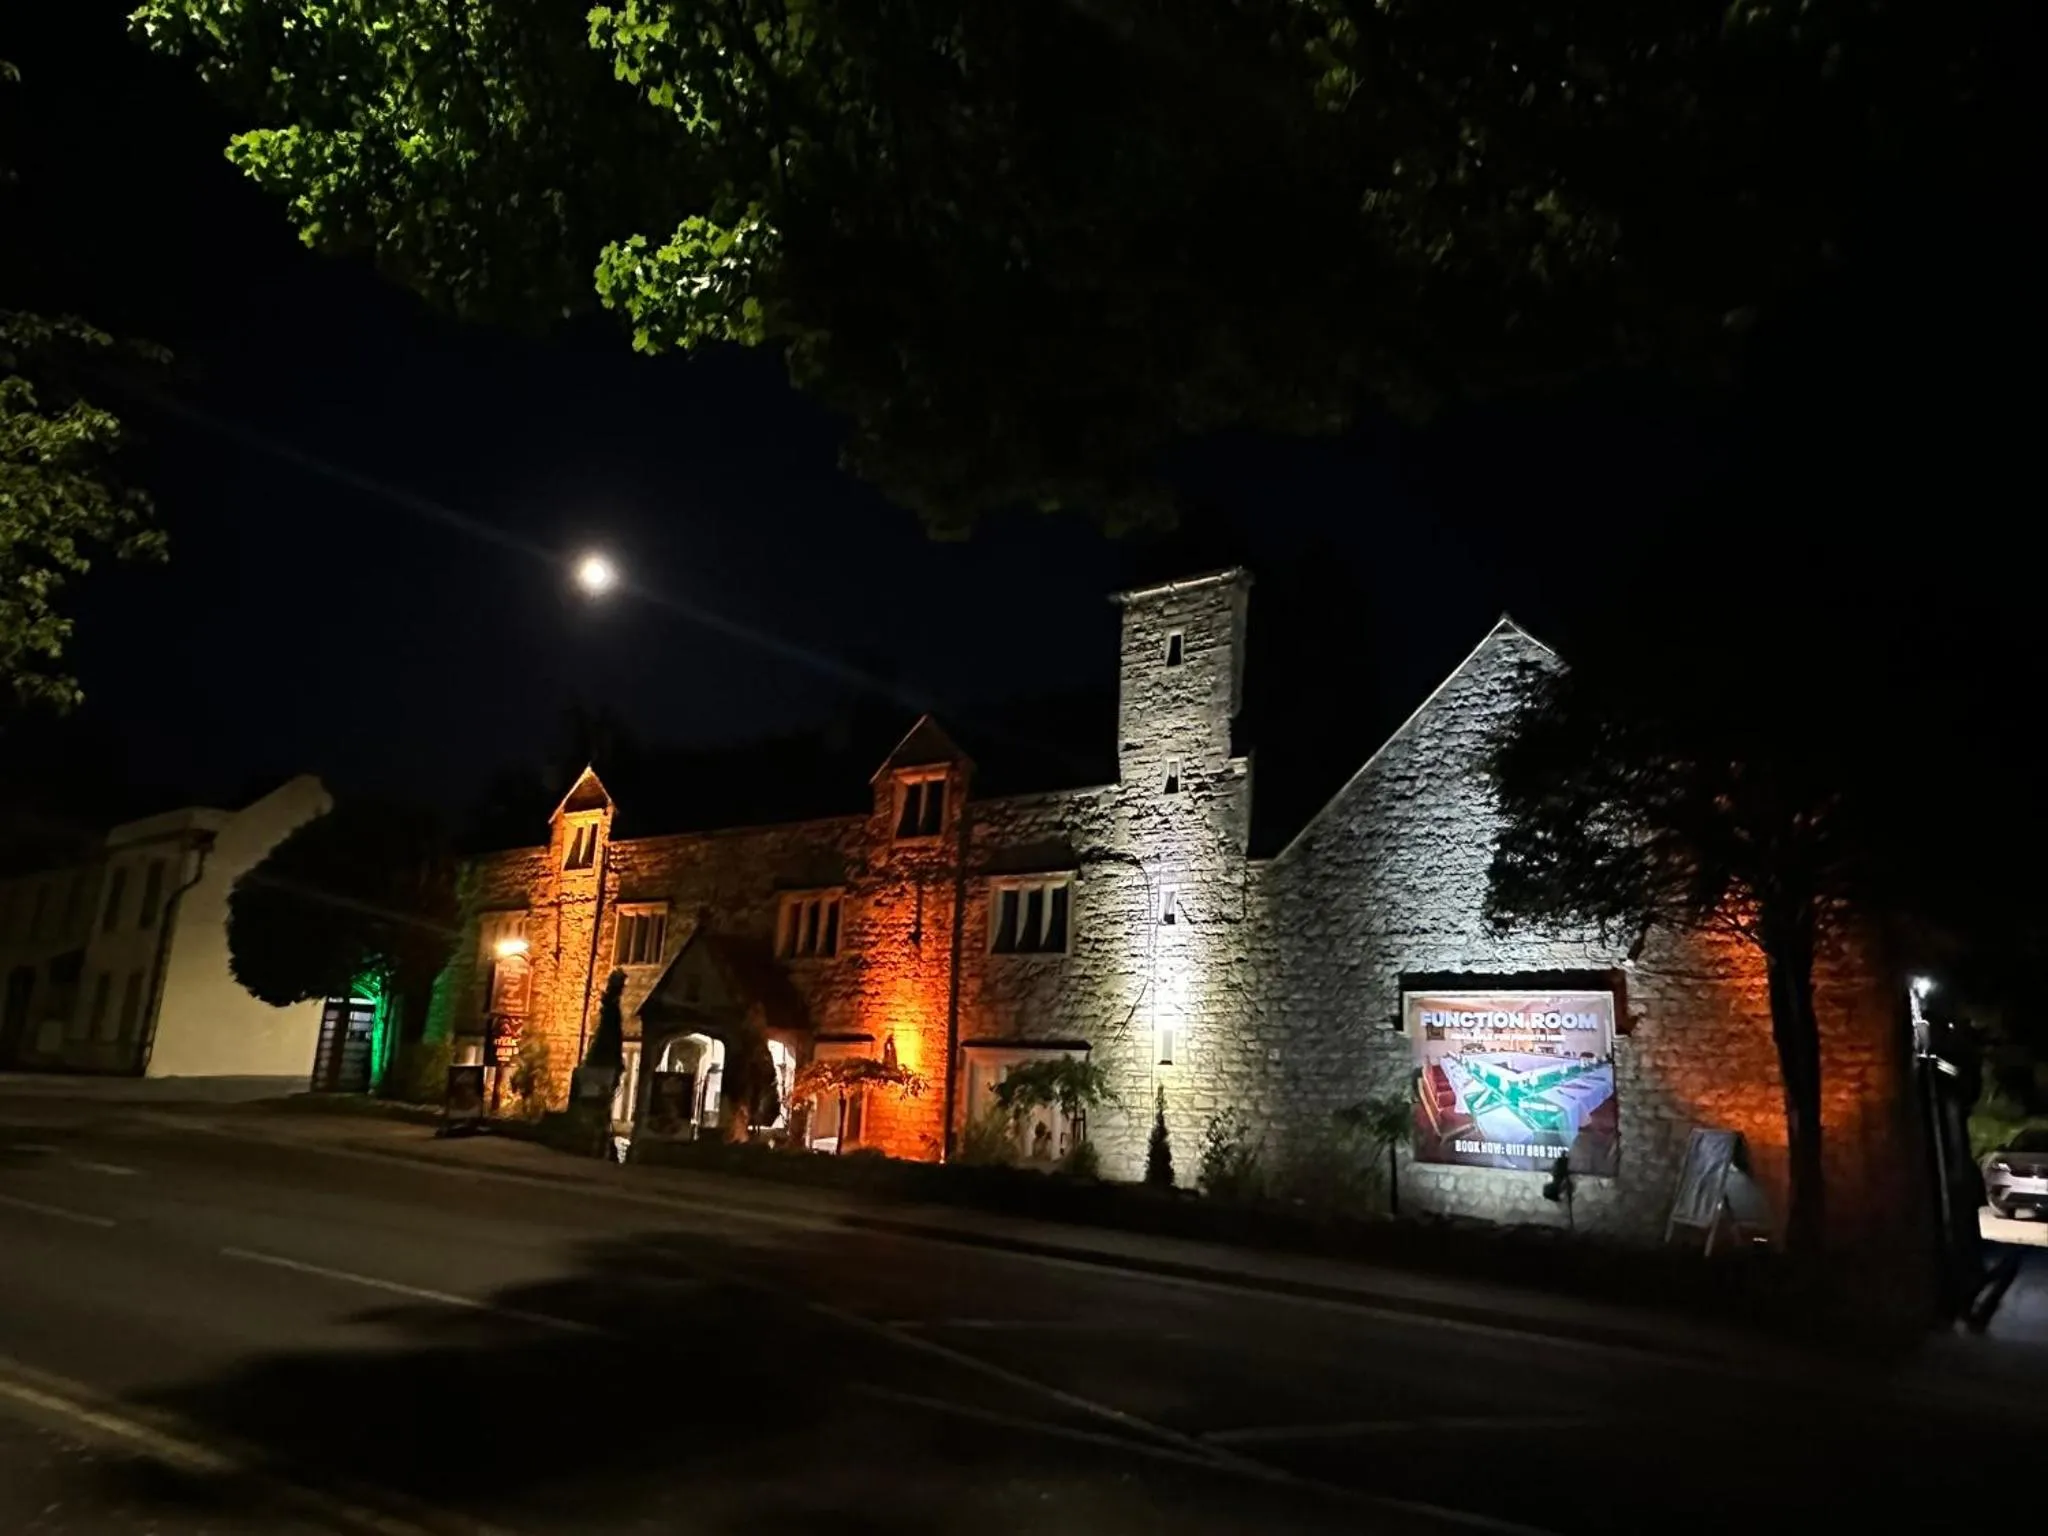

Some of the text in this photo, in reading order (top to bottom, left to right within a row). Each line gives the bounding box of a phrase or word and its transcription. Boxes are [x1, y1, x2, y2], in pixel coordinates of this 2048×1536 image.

[1420, 1011, 1598, 1030] FUNCTION ROOM
[1455, 1139, 1480, 1153] BOOK
